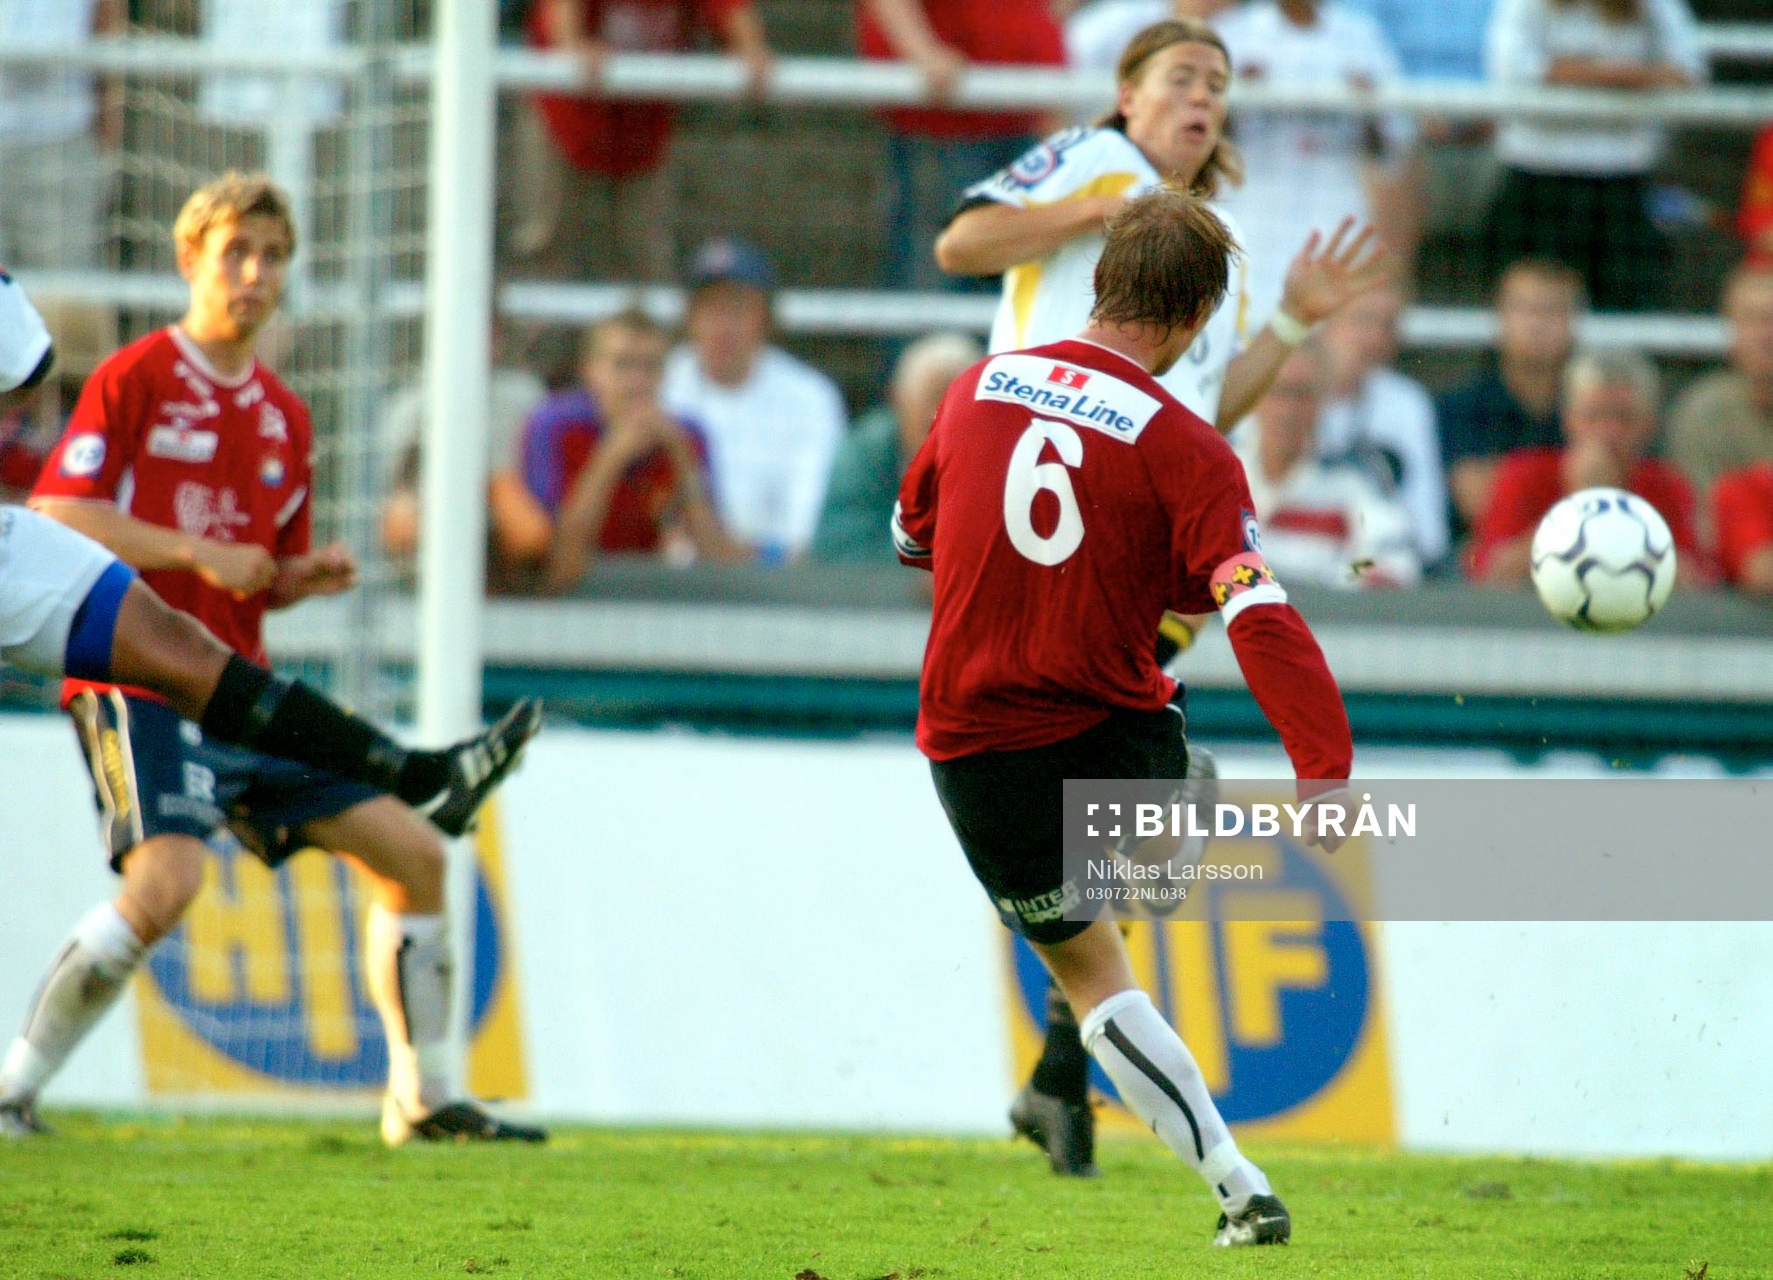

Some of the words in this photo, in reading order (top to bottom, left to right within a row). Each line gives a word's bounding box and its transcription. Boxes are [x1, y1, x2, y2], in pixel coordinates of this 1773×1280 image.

[985, 372, 1071, 410] Stena
[1070, 396, 1134, 431] Line
[1003, 417, 1085, 567] 6
